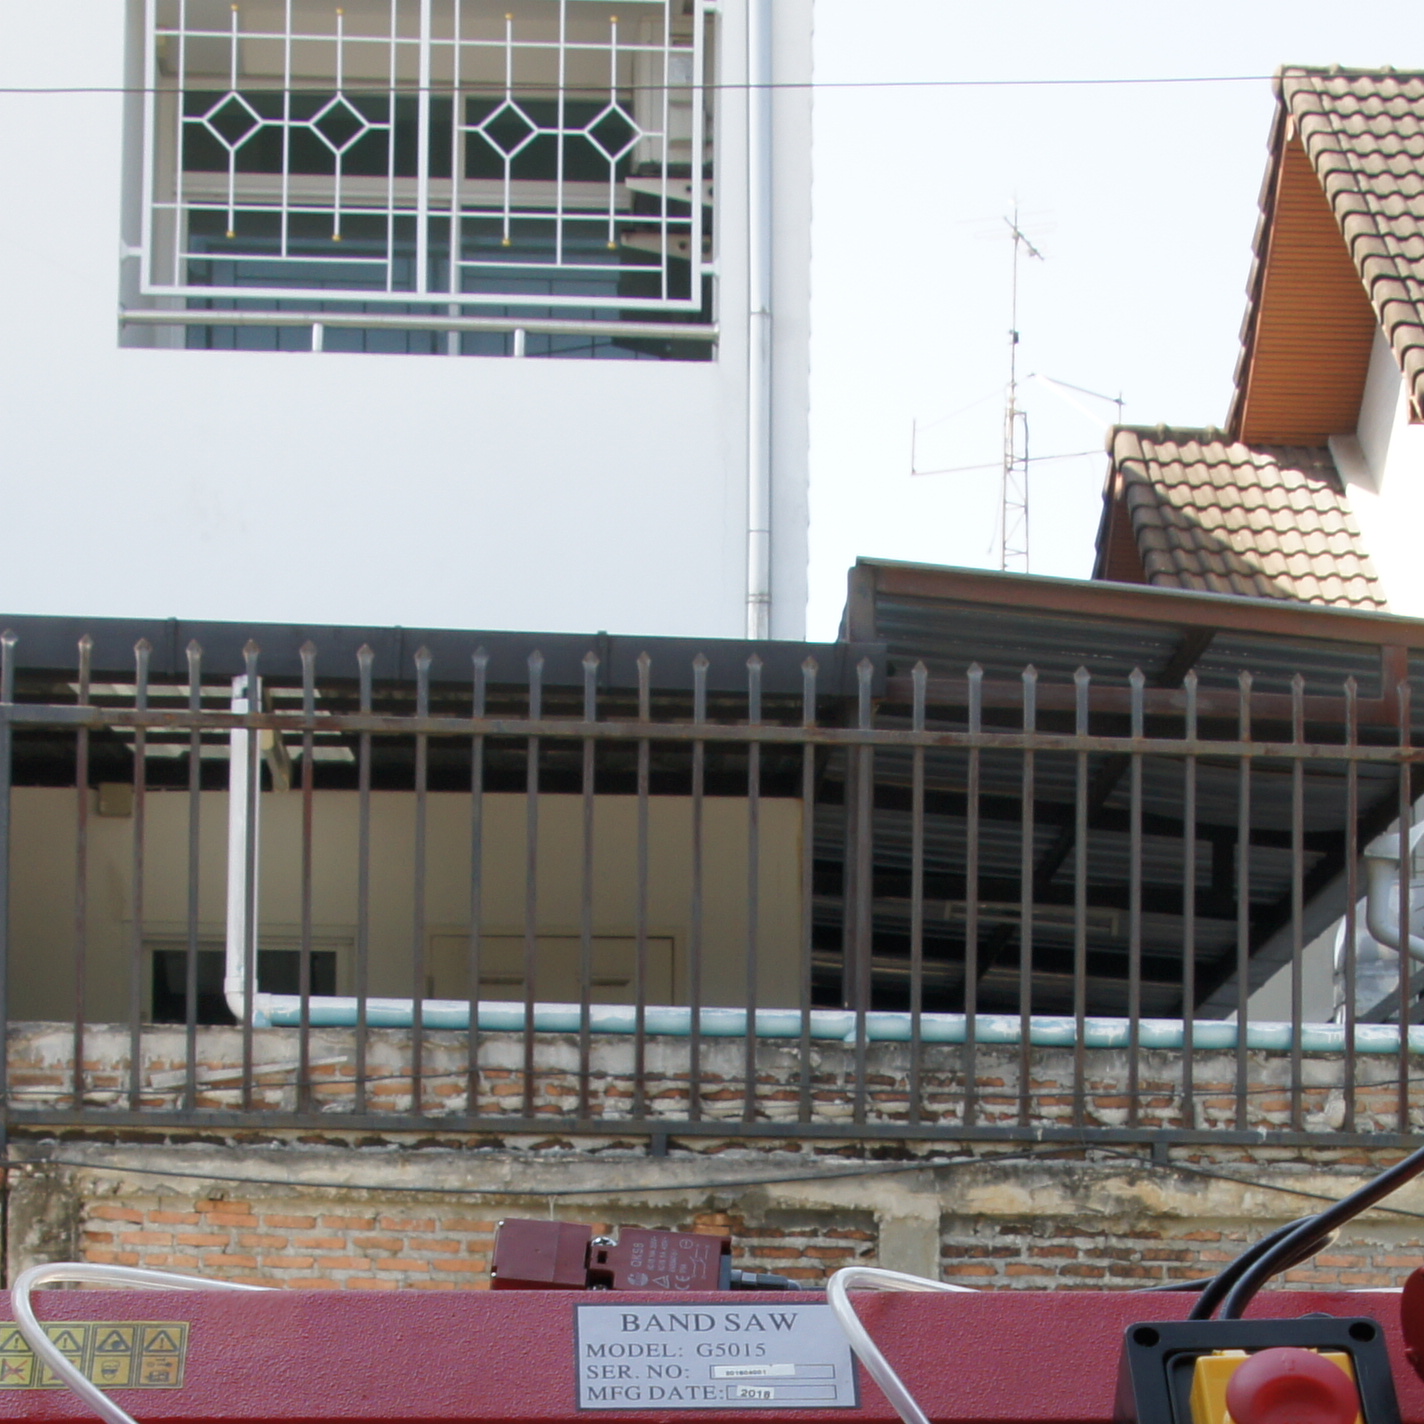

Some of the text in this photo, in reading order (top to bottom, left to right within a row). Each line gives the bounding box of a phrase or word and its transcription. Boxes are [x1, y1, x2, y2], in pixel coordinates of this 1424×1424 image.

[621, 1312, 799, 1333] BAND SAW
[586, 1343, 766, 1358] MODEL: G5015
[586, 1364, 640, 1379] SER.
[647, 1364, 690, 1379] NO:
[587, 1385, 771, 1401] MFG DATE: 2018
